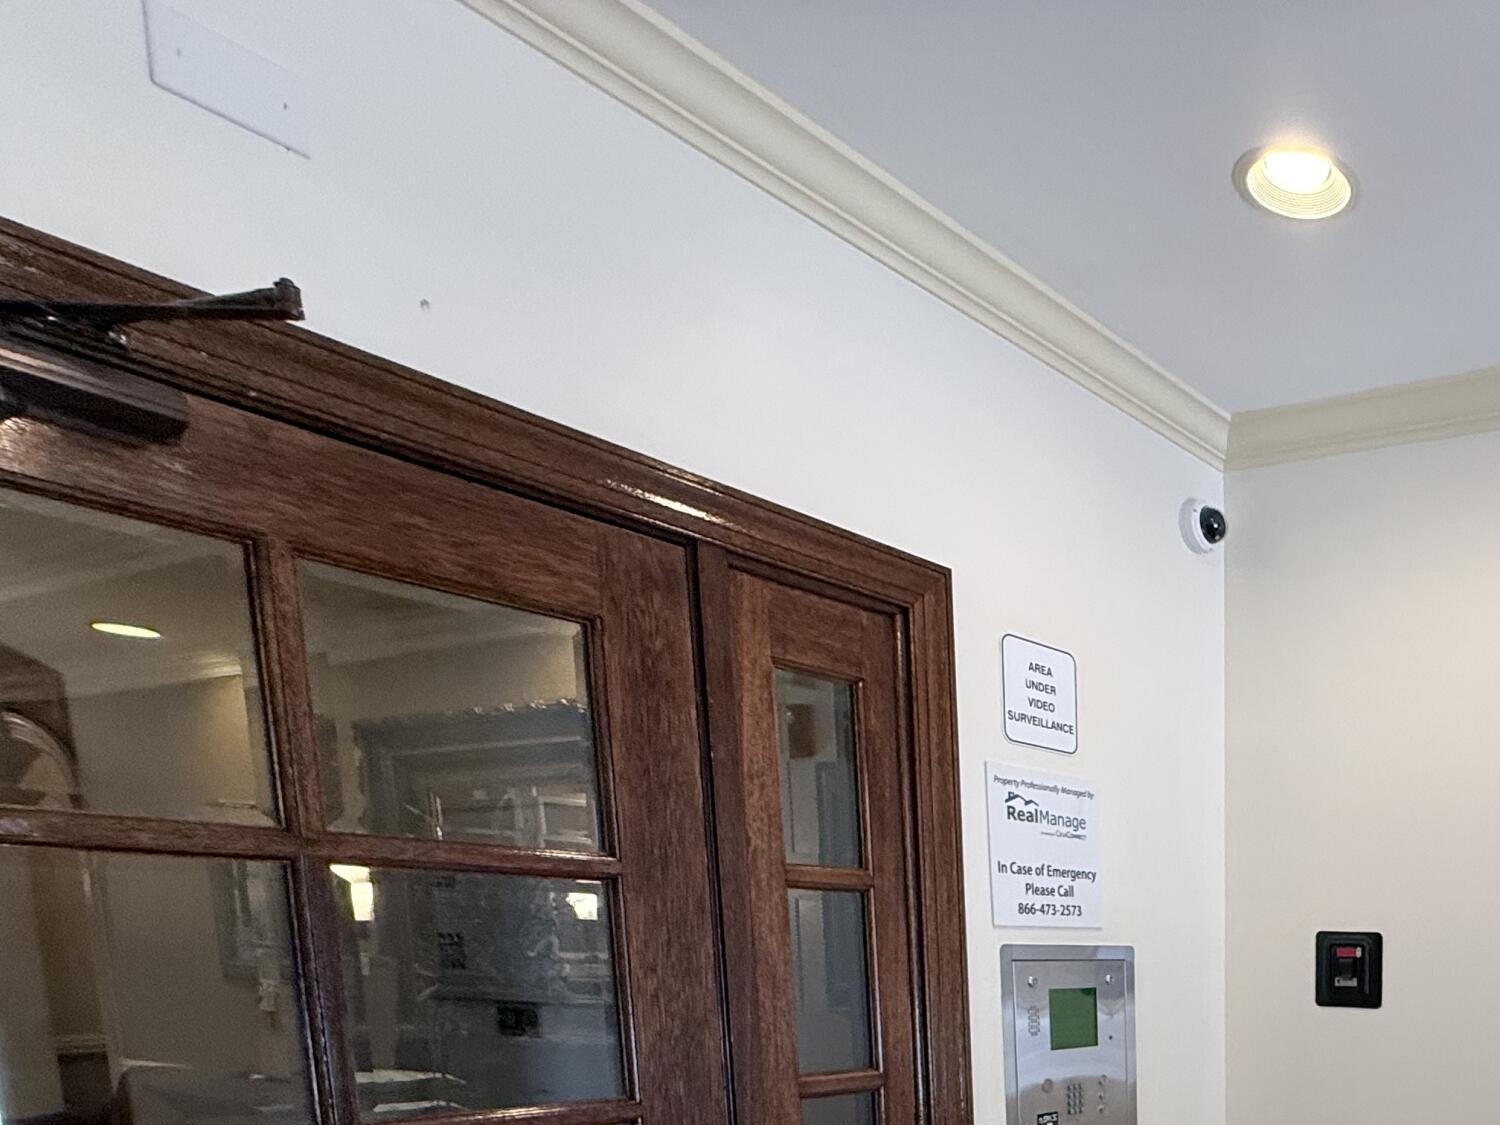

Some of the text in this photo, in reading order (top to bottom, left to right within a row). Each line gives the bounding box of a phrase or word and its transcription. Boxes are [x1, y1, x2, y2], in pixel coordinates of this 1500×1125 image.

[1028, 662, 1053, 677] AREA
[1025, 679, 1056, 695] UNDER
[1027, 697, 1055, 713] VIDEO
[1007, 710, 1075, 735] SURVEILLANCE
[993, 775, 1019, 788] Property
[1007, 806, 1086, 831] RealManage
[998, 861, 1096, 882] In Case of Emergency
[1025, 883, 1074, 897] Please Call
[1017, 902, 1082, 917] 866-473-2573
